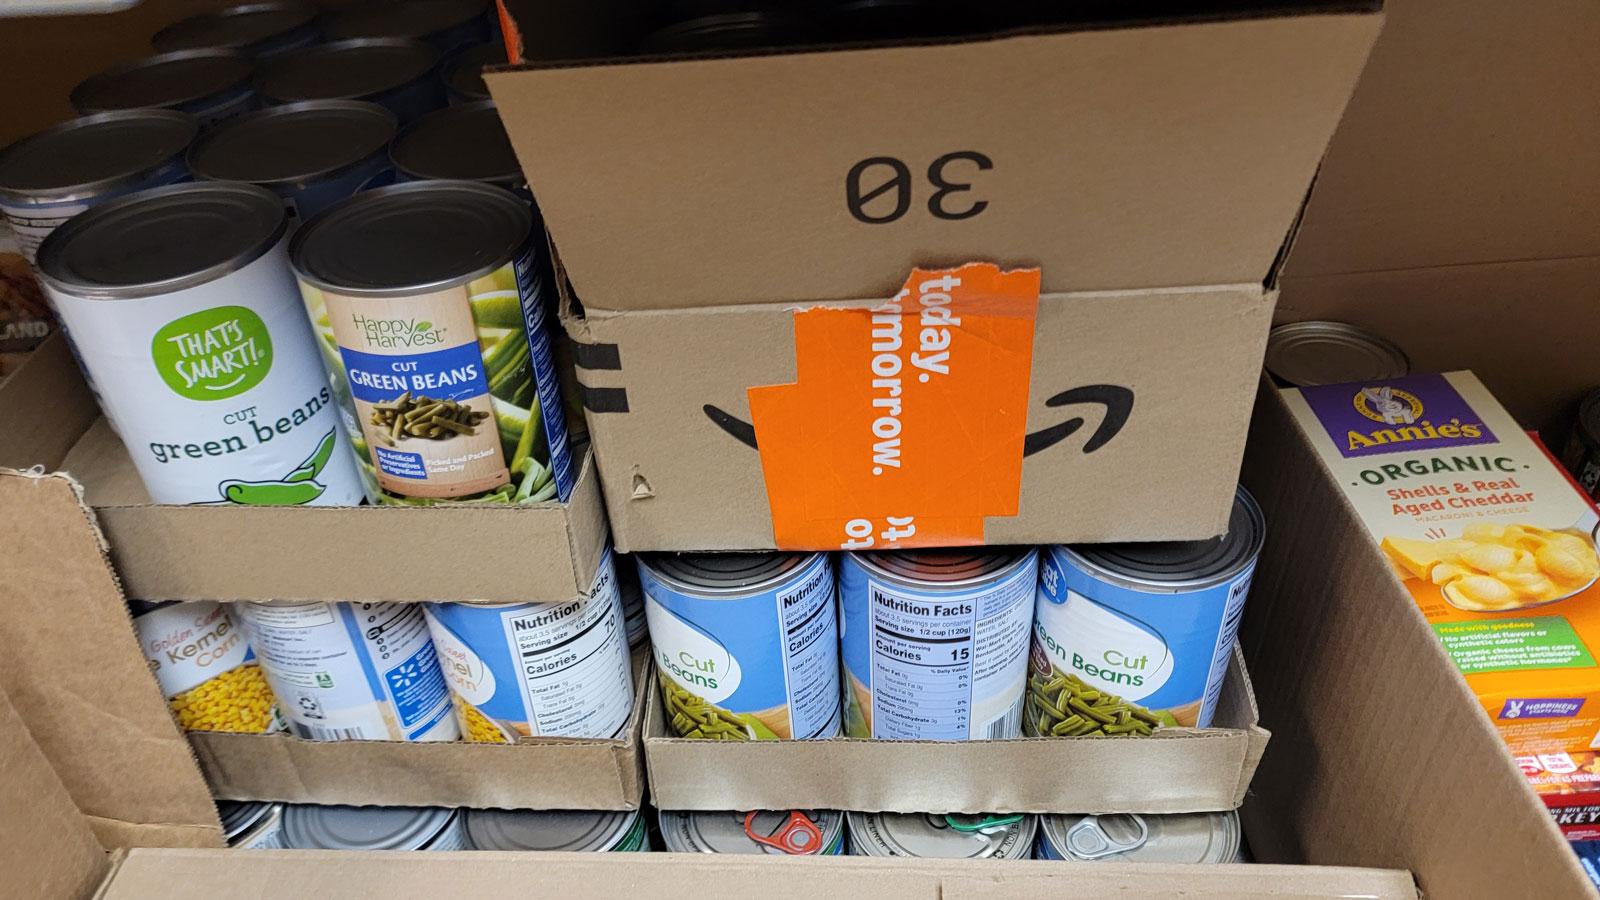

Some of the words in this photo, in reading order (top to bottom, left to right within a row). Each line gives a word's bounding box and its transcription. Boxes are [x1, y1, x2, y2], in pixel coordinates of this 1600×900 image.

[846, 150, 994, 225] 30
[352, 313, 416, 335] Happy
[910, 274, 962, 384] today.
[167, 319, 243, 358] THAT'S
[366, 328, 445, 348] Harvest
[350, 368, 408, 391] GREEN
[412, 364, 478, 391] BEANS
[391, 361, 418, 372] CUT
[150, 435, 247, 463] green
[249, 386, 331, 444] beans
[223, 406, 257, 425] CUT
[1347, 418, 1482, 450] Annie's
[468, 448, 495, 460] Packed
[450, 463, 465, 472] Day
[1359, 455, 1516, 486] ORGANIC
[1386, 483, 1450, 502] Shells
[1455, 481, 1469, 493] &
[1475, 477, 1521, 492] Real
[1391, 498, 1445, 516] Aged
[1449, 491, 1535, 508] Cheddar
[1415, 511, 1474, 524] MACARONI
[1486, 507, 1531, 517] CHEESE
[783, 572, 824, 609] Nutrition
[514, 601, 580, 632] Nutrition
[585, 572, 609, 604] acts
[874, 591, 930, 616] Nutrition
[934, 604, 972, 617] Facts
[604, 614, 615, 633] 70
[786, 610, 807, 627] Serving
[875, 615, 899, 630] Serving
[948, 626, 971, 636] (120g)
[902, 618, 928, 628] servings
[942, 619, 972, 627] container
[166, 614, 233, 664] Kernel
[520, 639, 551, 650] Serving
[553, 631, 568, 640] size
[789, 622, 823, 652] Calories
[1448, 639, 1493, 649] synthetic
[196, 633, 241, 667] Corn
[876, 640, 922, 661] Calories
[951, 648, 970, 661] 15
[1103, 650, 1148, 670] Cut
[1454, 649, 1491, 658] Organic
[527, 653, 577, 675] Calories
[662, 653, 719, 689] Beans
[679, 651, 716, 673] Cut
[1072, 653, 1144, 687] Beans
[1473, 660, 1519, 669] synthetic
[891, 710, 930, 723] Carbohydrate
[1553, 812, 1600, 824] KEY
